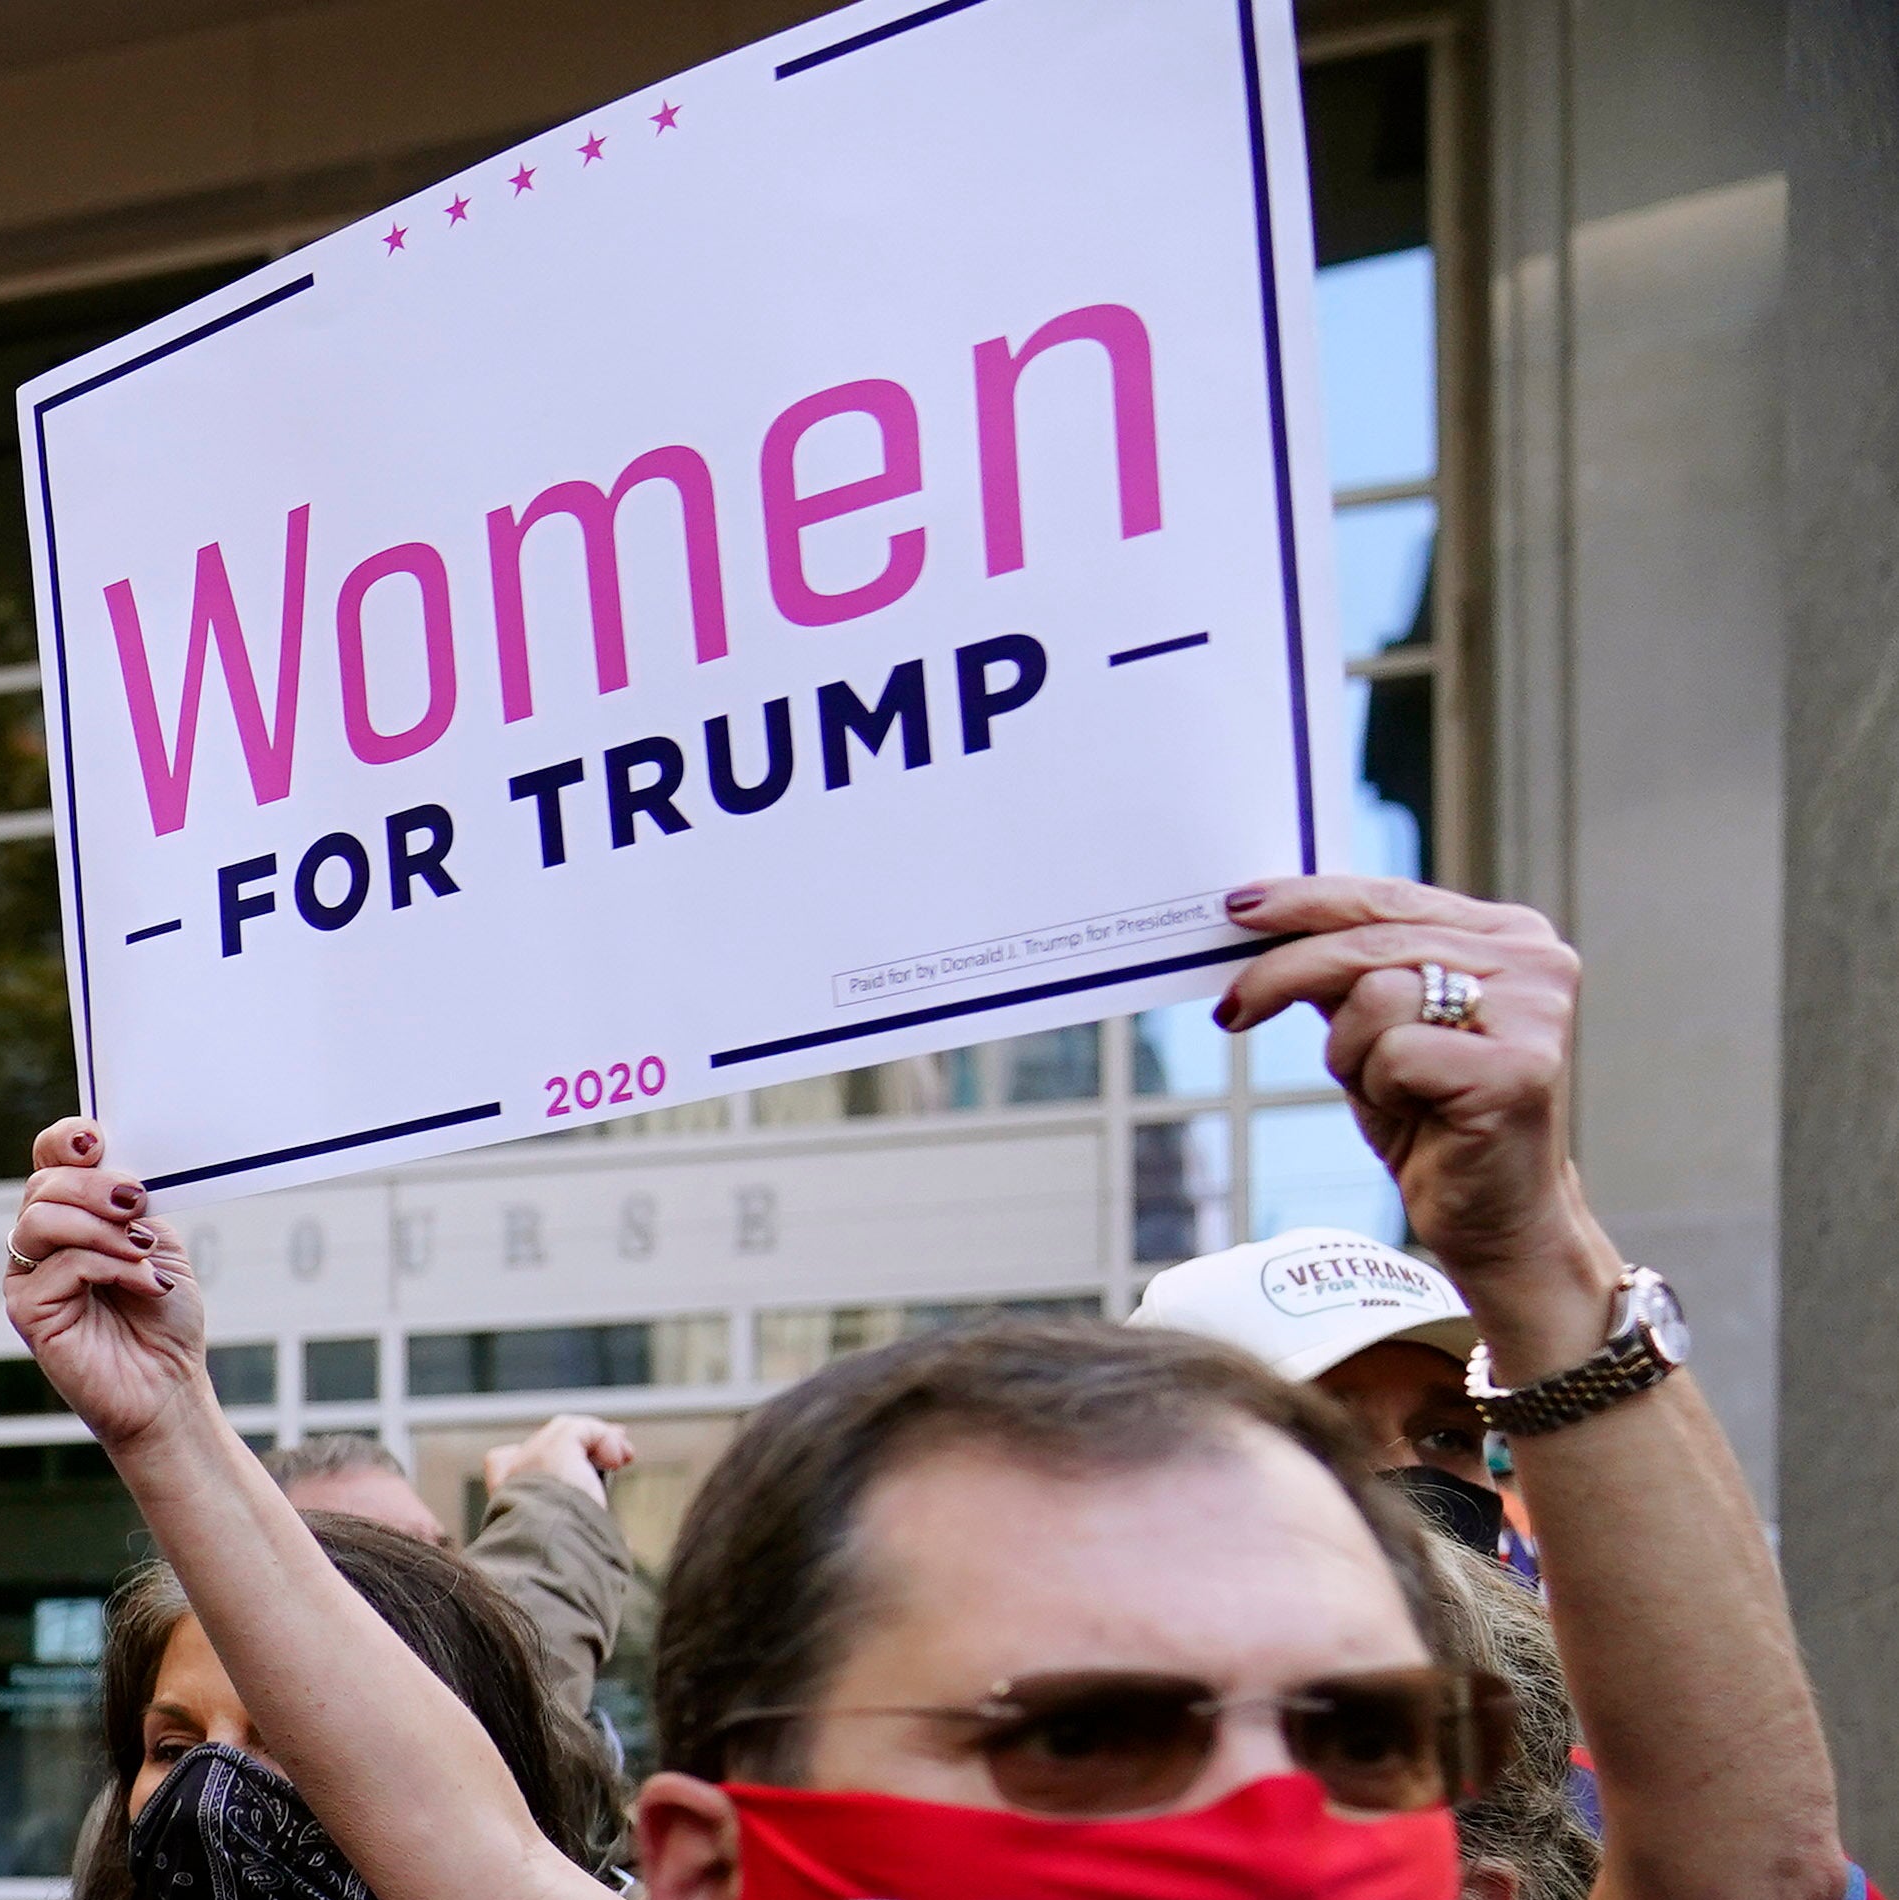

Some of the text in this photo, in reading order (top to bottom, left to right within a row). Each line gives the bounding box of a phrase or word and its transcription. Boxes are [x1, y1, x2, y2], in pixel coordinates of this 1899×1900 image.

[103, 302, 1163, 838] Women
[217, 632, 1049, 958] FOR TRUMP
[849, 976, 885, 993] Paid
[888, 968, 912, 985] for
[915, 963, 937, 981] by
[940, 946, 1004, 974] Donald
[1022, 932, 1083, 955] Trump
[1086, 924, 1112, 942] for
[544, 1055, 668, 1118] 2020
[1286, 1256, 1431, 1291] VETERANS
[1315, 1279, 1357, 1295] FOR
